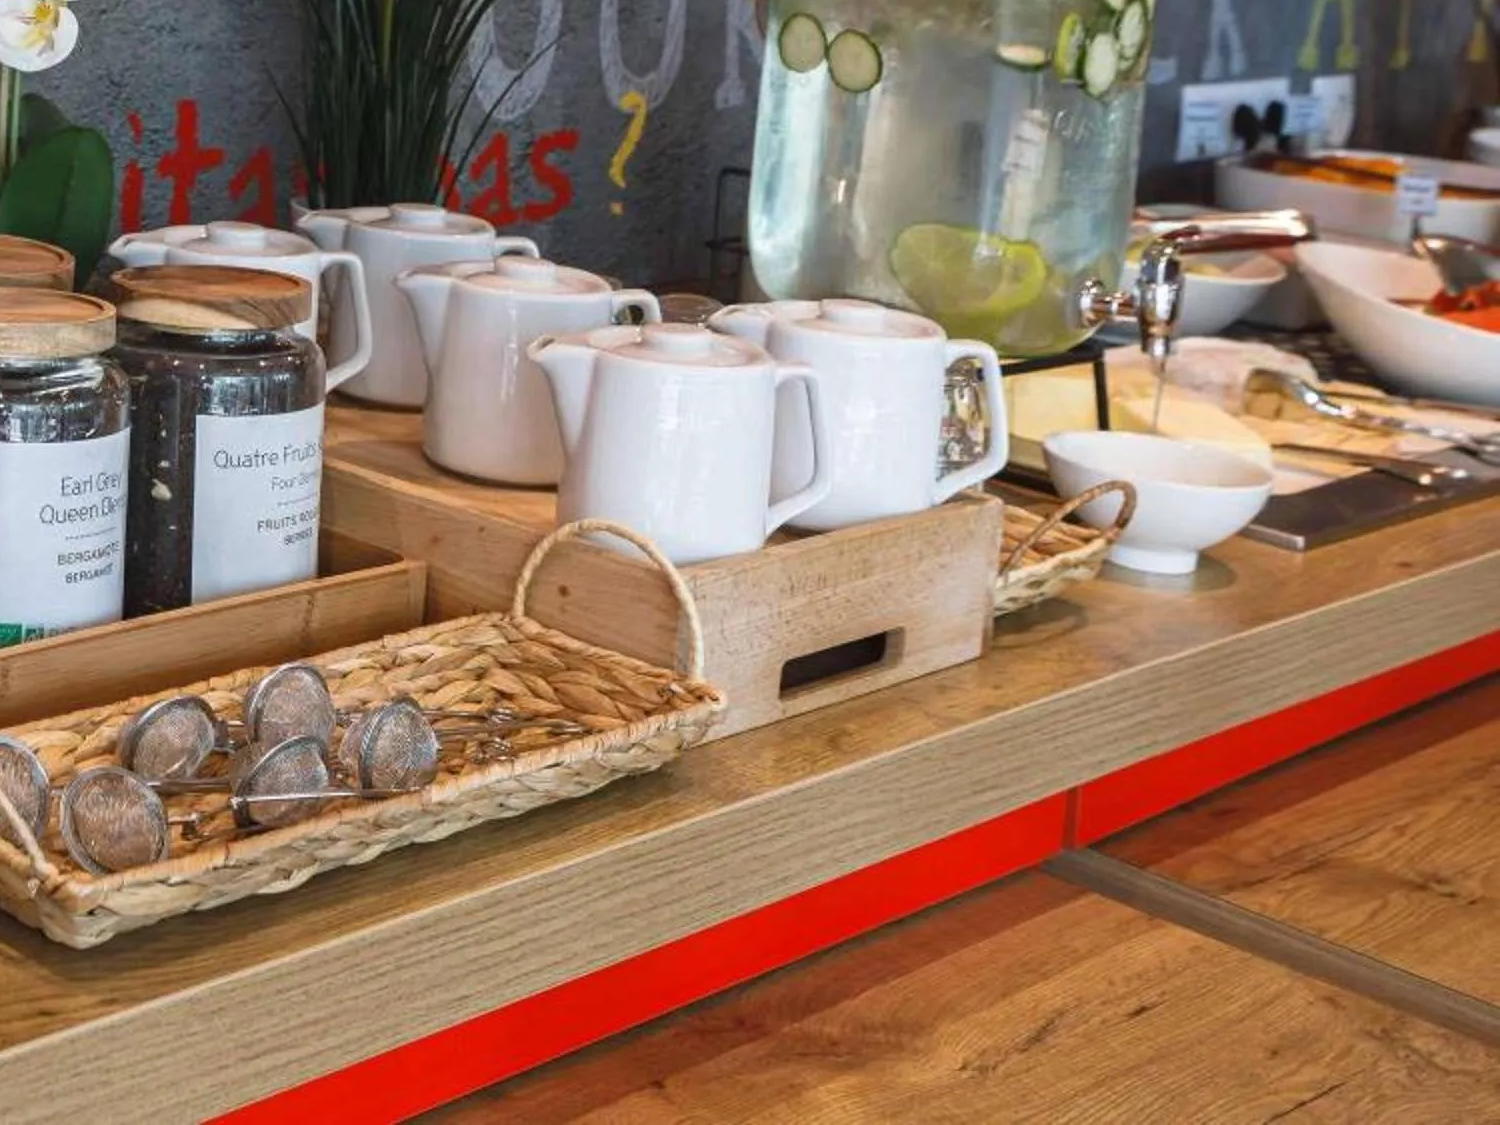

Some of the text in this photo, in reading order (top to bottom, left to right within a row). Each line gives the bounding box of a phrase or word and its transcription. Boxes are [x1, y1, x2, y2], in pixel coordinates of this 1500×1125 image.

[212, 448, 280, 470] Quatre
[60, 475, 94, 498] Earl
[39, 504, 99, 525] Queen
